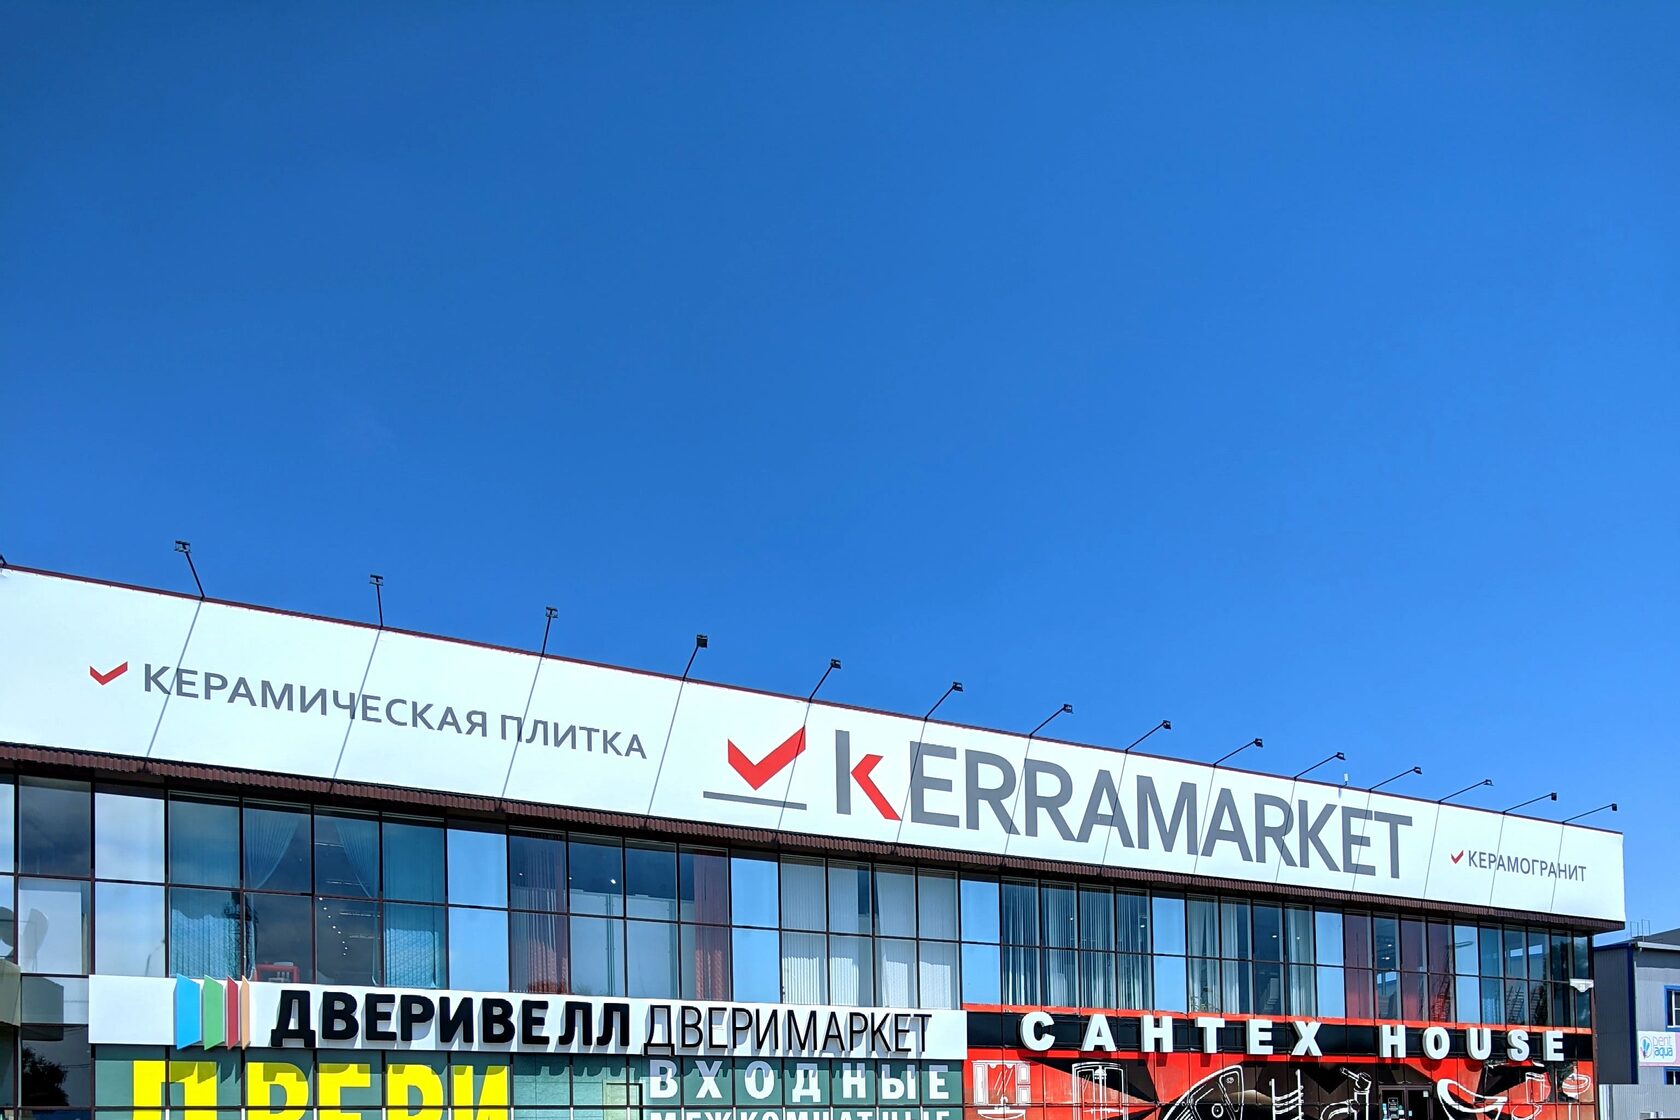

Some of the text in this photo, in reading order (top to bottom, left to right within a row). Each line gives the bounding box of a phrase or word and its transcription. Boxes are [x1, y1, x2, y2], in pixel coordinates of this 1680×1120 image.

[144, 663, 647, 759] КЕРАМИЧЕСКАЯ ПЛИТКА
[835, 729, 1413, 879] KERRAMARKET
[1468, 850, 1587, 882] КЕРАМОГРАНИТ
[271, 990, 932, 1057] ДВЕРИВЕЛЛ ДВЕРИМАРКЕТ
[1020, 1011, 1565, 1062] САНТЕХ HOUSE
[1654, 1047, 1673, 1059] aqua
[649, 1059, 950, 1103] ВХОДНЫЕ
